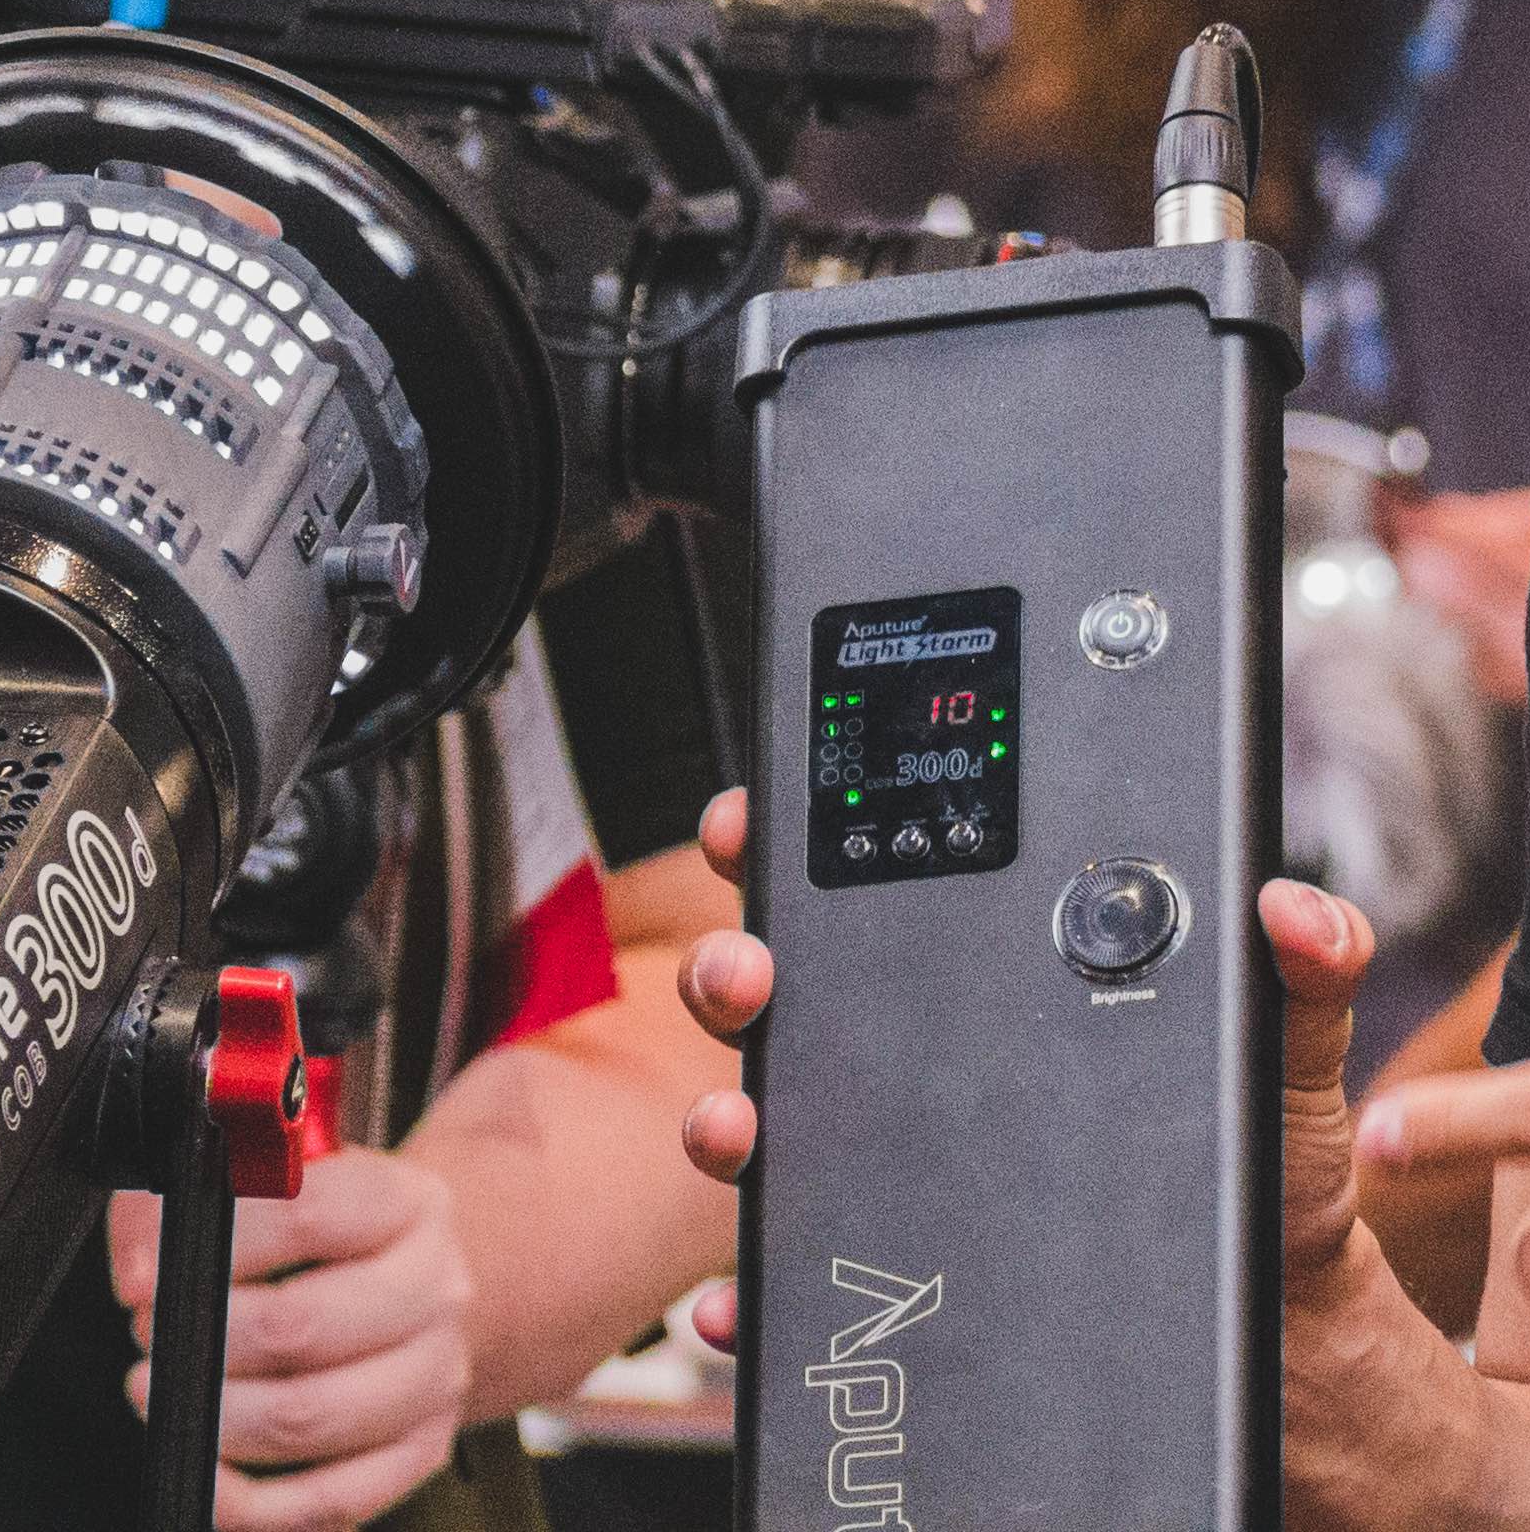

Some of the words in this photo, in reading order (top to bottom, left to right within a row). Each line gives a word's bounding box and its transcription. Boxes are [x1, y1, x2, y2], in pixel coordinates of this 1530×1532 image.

[843, 616, 924, 640] Aputure
[843, 640, 905, 664] Light
[931, 690, 976, 725] 10
[1, 1040, 48, 1132] COB
